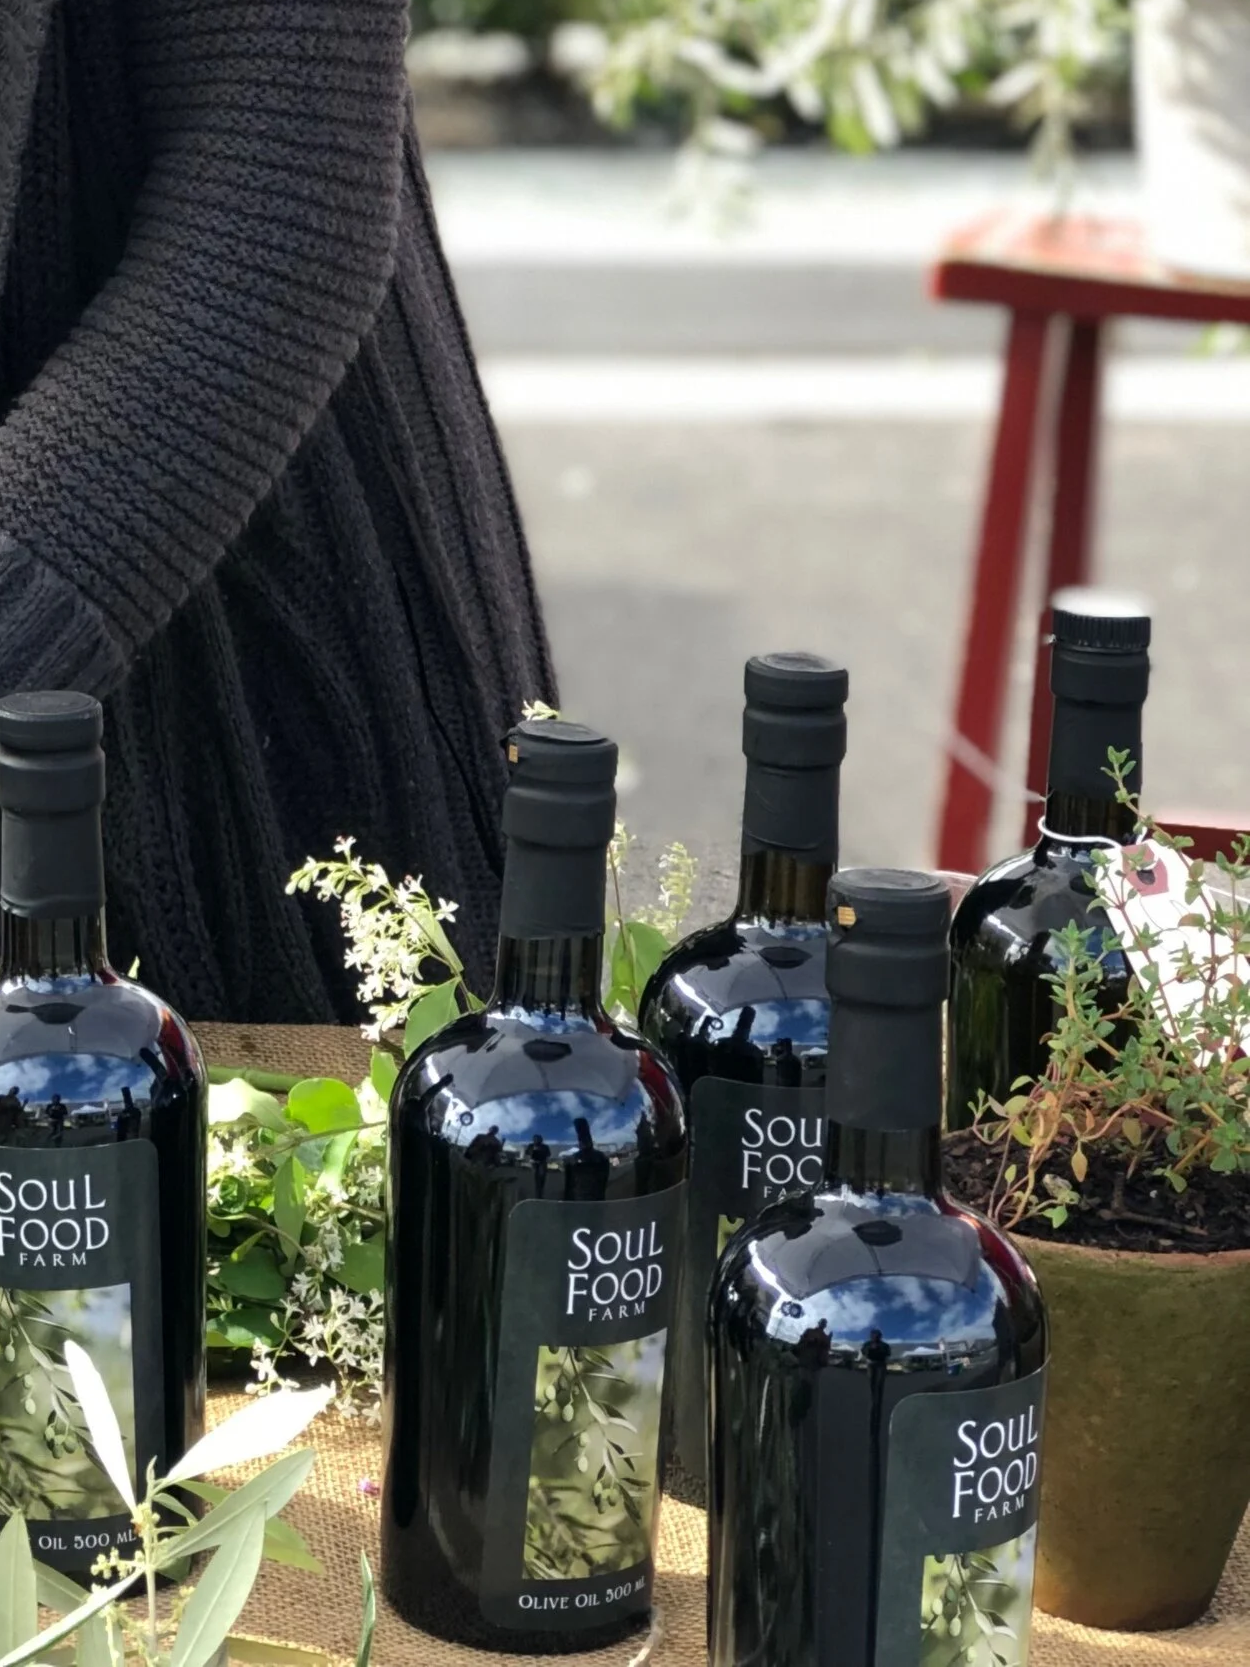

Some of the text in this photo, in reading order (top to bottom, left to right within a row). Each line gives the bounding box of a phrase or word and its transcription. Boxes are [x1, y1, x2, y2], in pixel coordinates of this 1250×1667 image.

[741, 1108, 823, 1148] SOU
[741, 1150, 823, 1189] FOO
[19, 1252, 87, 1267] FARM
[566, 1264, 662, 1315] FOOD
[588, 1301, 646, 1322] FARM
[952, 1451, 1037, 1518] FOOD
[974, 1494, 1025, 1524] FARM
[38, 1535, 68, 1550] OIL
[74, 1533, 110, 1549] 500
[116, 1529, 137, 1544] ML
[518, 1594, 570, 1610] OLIVE
[575, 1593, 601, 1608] OIL
[605, 1582, 633, 1603] 500
